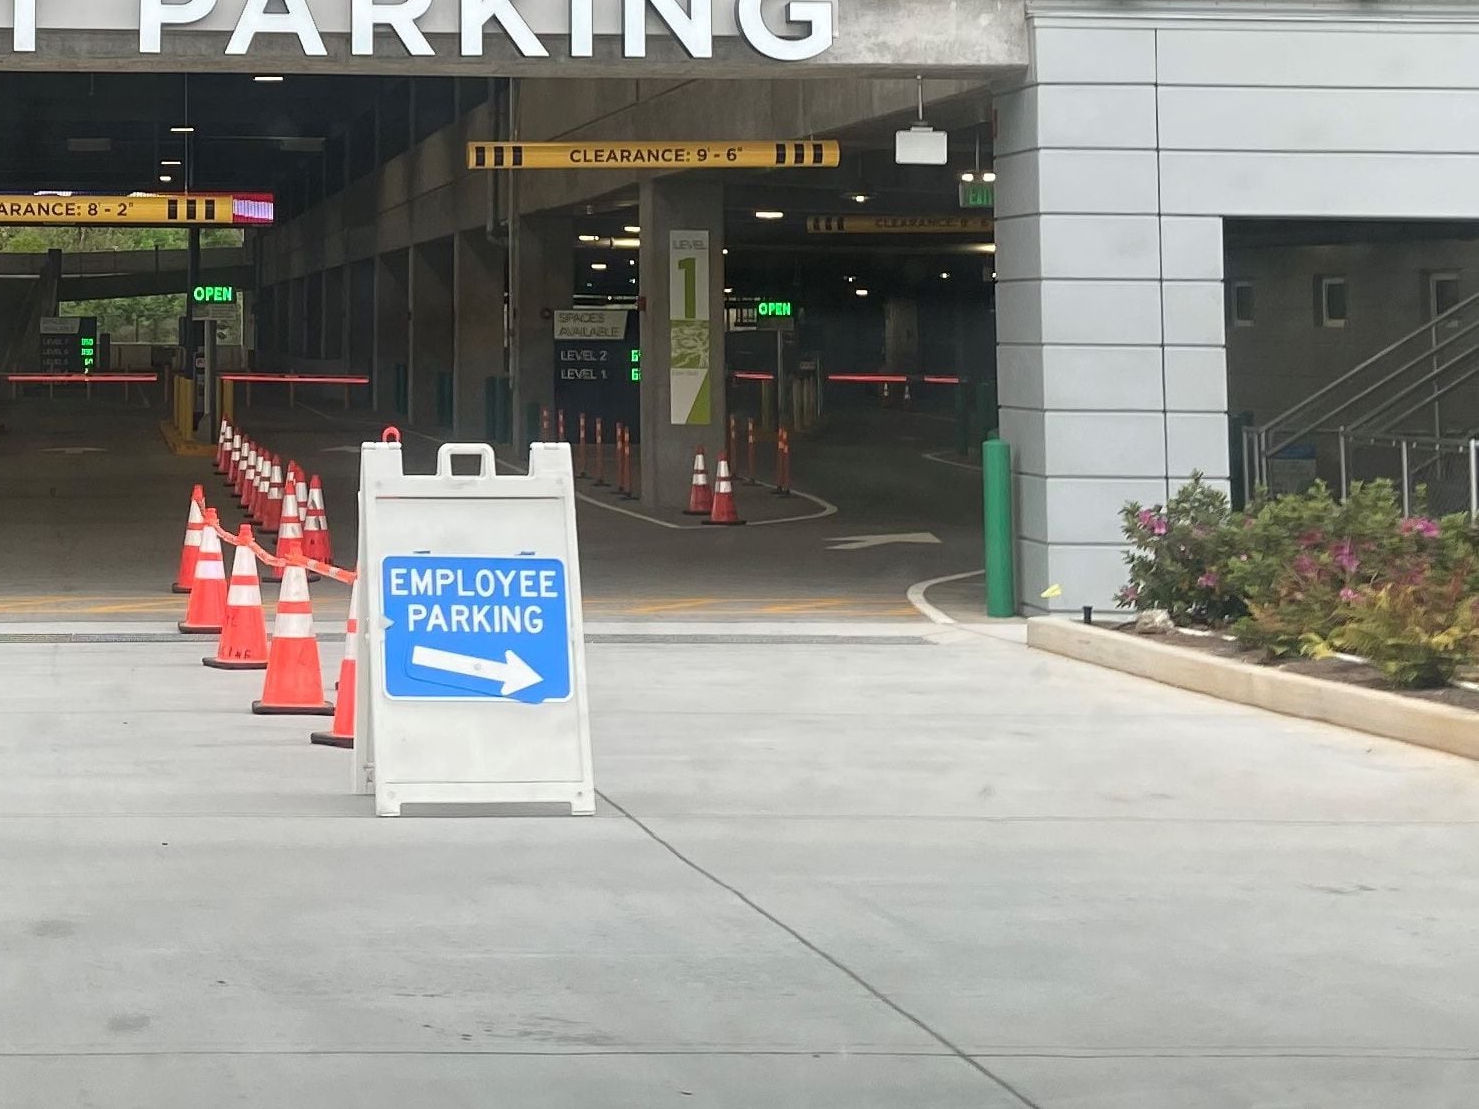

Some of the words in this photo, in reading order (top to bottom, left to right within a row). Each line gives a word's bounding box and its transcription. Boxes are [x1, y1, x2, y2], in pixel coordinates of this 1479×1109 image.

[569, 148, 691, 163] CLEARANCE:
[673, 240, 707, 250] LEVEL
[193, 286, 233, 301] OPEN
[678, 257, 696, 319] 1
[758, 302, 791, 316] OPEN
[558, 312, 605, 324] SPACES
[559, 326, 620, 337] AVAILABLE
[560, 350, 597, 361] LEVEL
[599, 350, 607, 361] 2
[561, 369, 597, 380] LEVEL
[601, 369, 607, 380] 1
[390, 568, 559, 598] EMPLOYEE
[407, 603, 544, 634] PARKING
